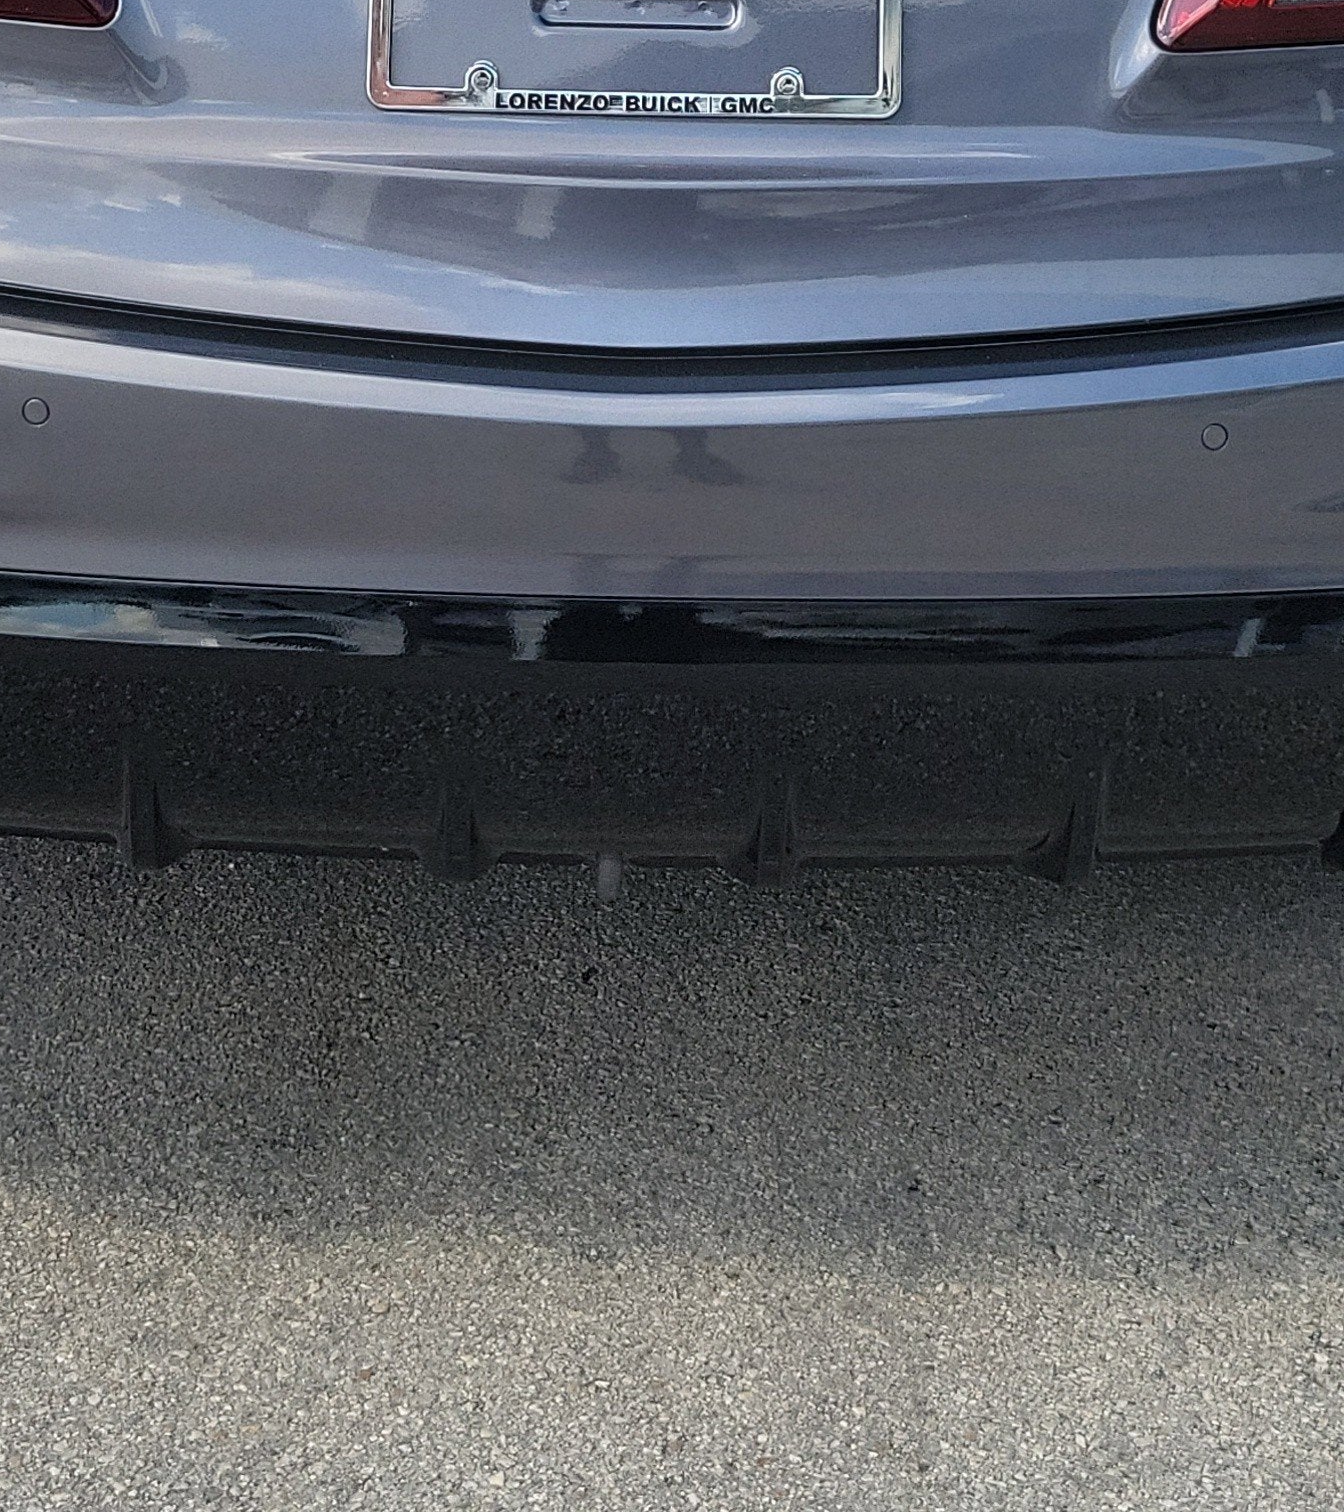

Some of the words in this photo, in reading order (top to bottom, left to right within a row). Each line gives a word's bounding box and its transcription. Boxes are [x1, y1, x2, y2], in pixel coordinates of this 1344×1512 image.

[495, 93, 609, 110] LORENZO
[624, 96, 700, 112] BUICK
[720, 98, 773, 113] GMC
